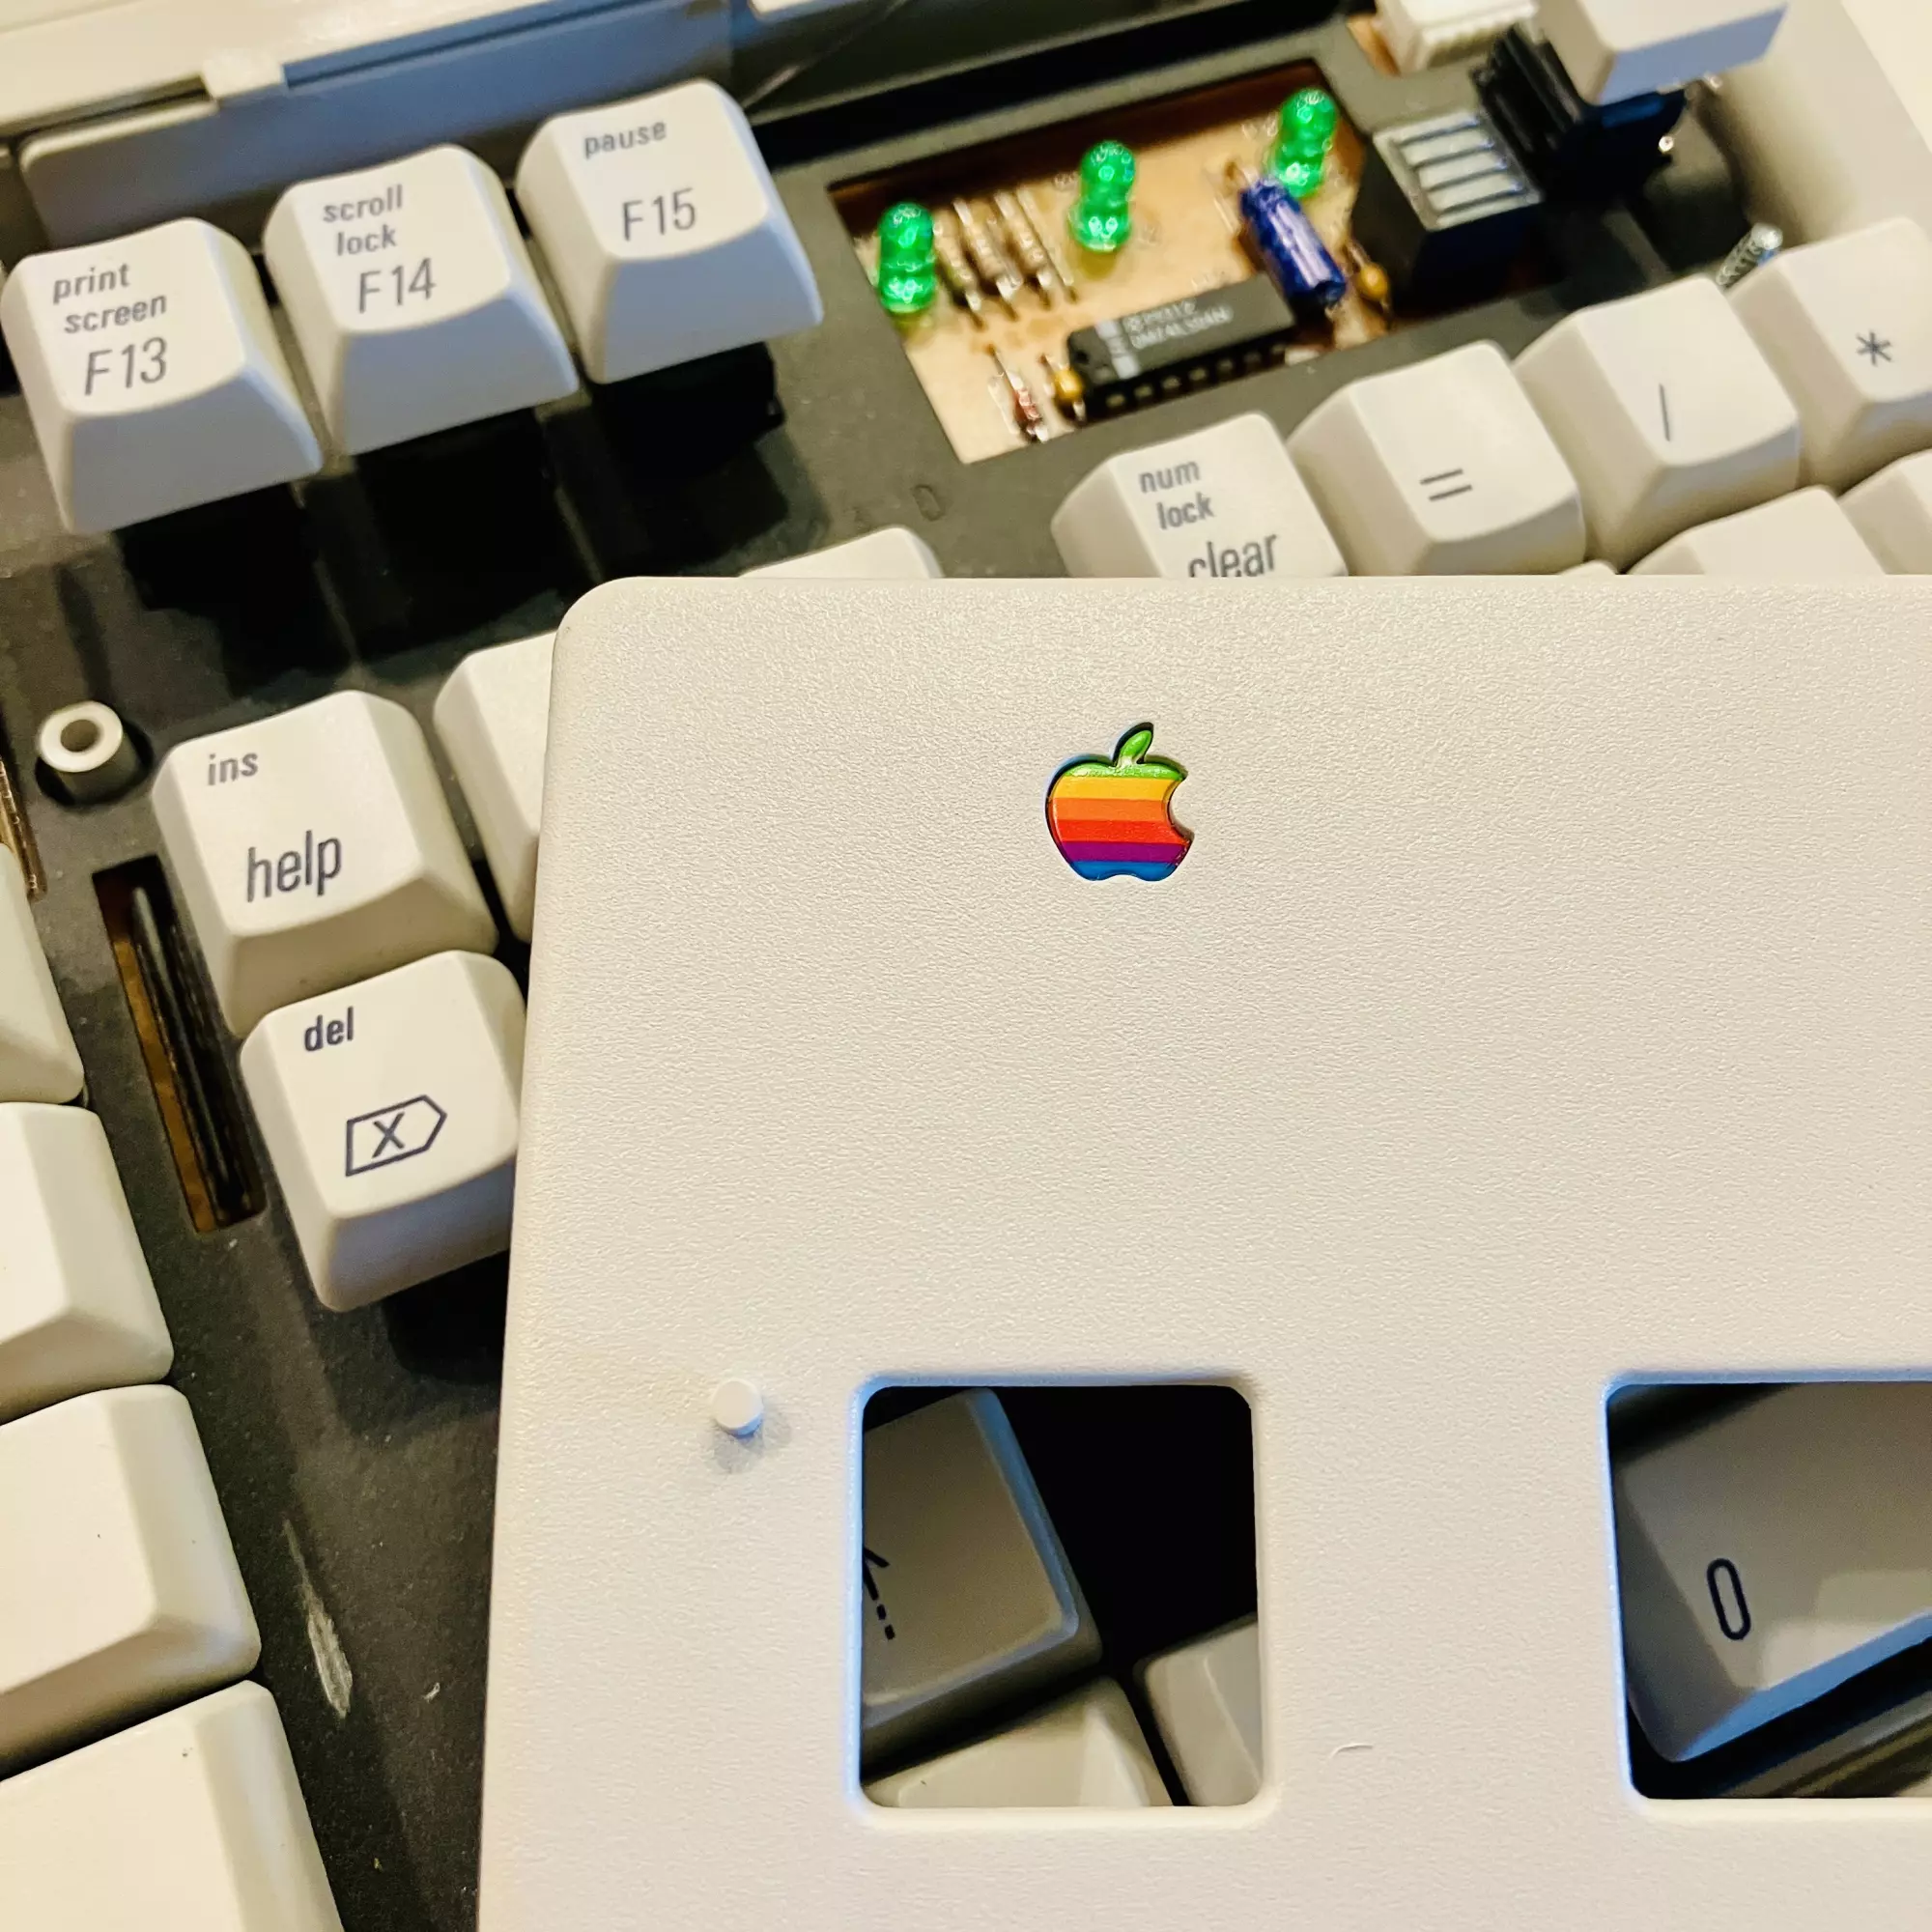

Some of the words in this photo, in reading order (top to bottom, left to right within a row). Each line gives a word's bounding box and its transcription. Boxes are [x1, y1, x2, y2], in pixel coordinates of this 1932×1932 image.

[584, 120, 667, 159] pause
[322, 185, 404, 223] scroll
[621, 187, 697, 241] F15
[335, 222, 397, 257] lock
[52, 261, 130, 304] print
[357, 256, 436, 314] F14
[64, 291, 167, 335] screen
[83, 335, 168, 396] F13
[1139, 461, 1201, 494] num
[1156, 491, 1215, 530] lock
[1188, 533, 1277, 577] clear
[207, 752, 259, 786] ins
[246, 829, 343, 903] help
[302, 1006, 355, 1053] del
